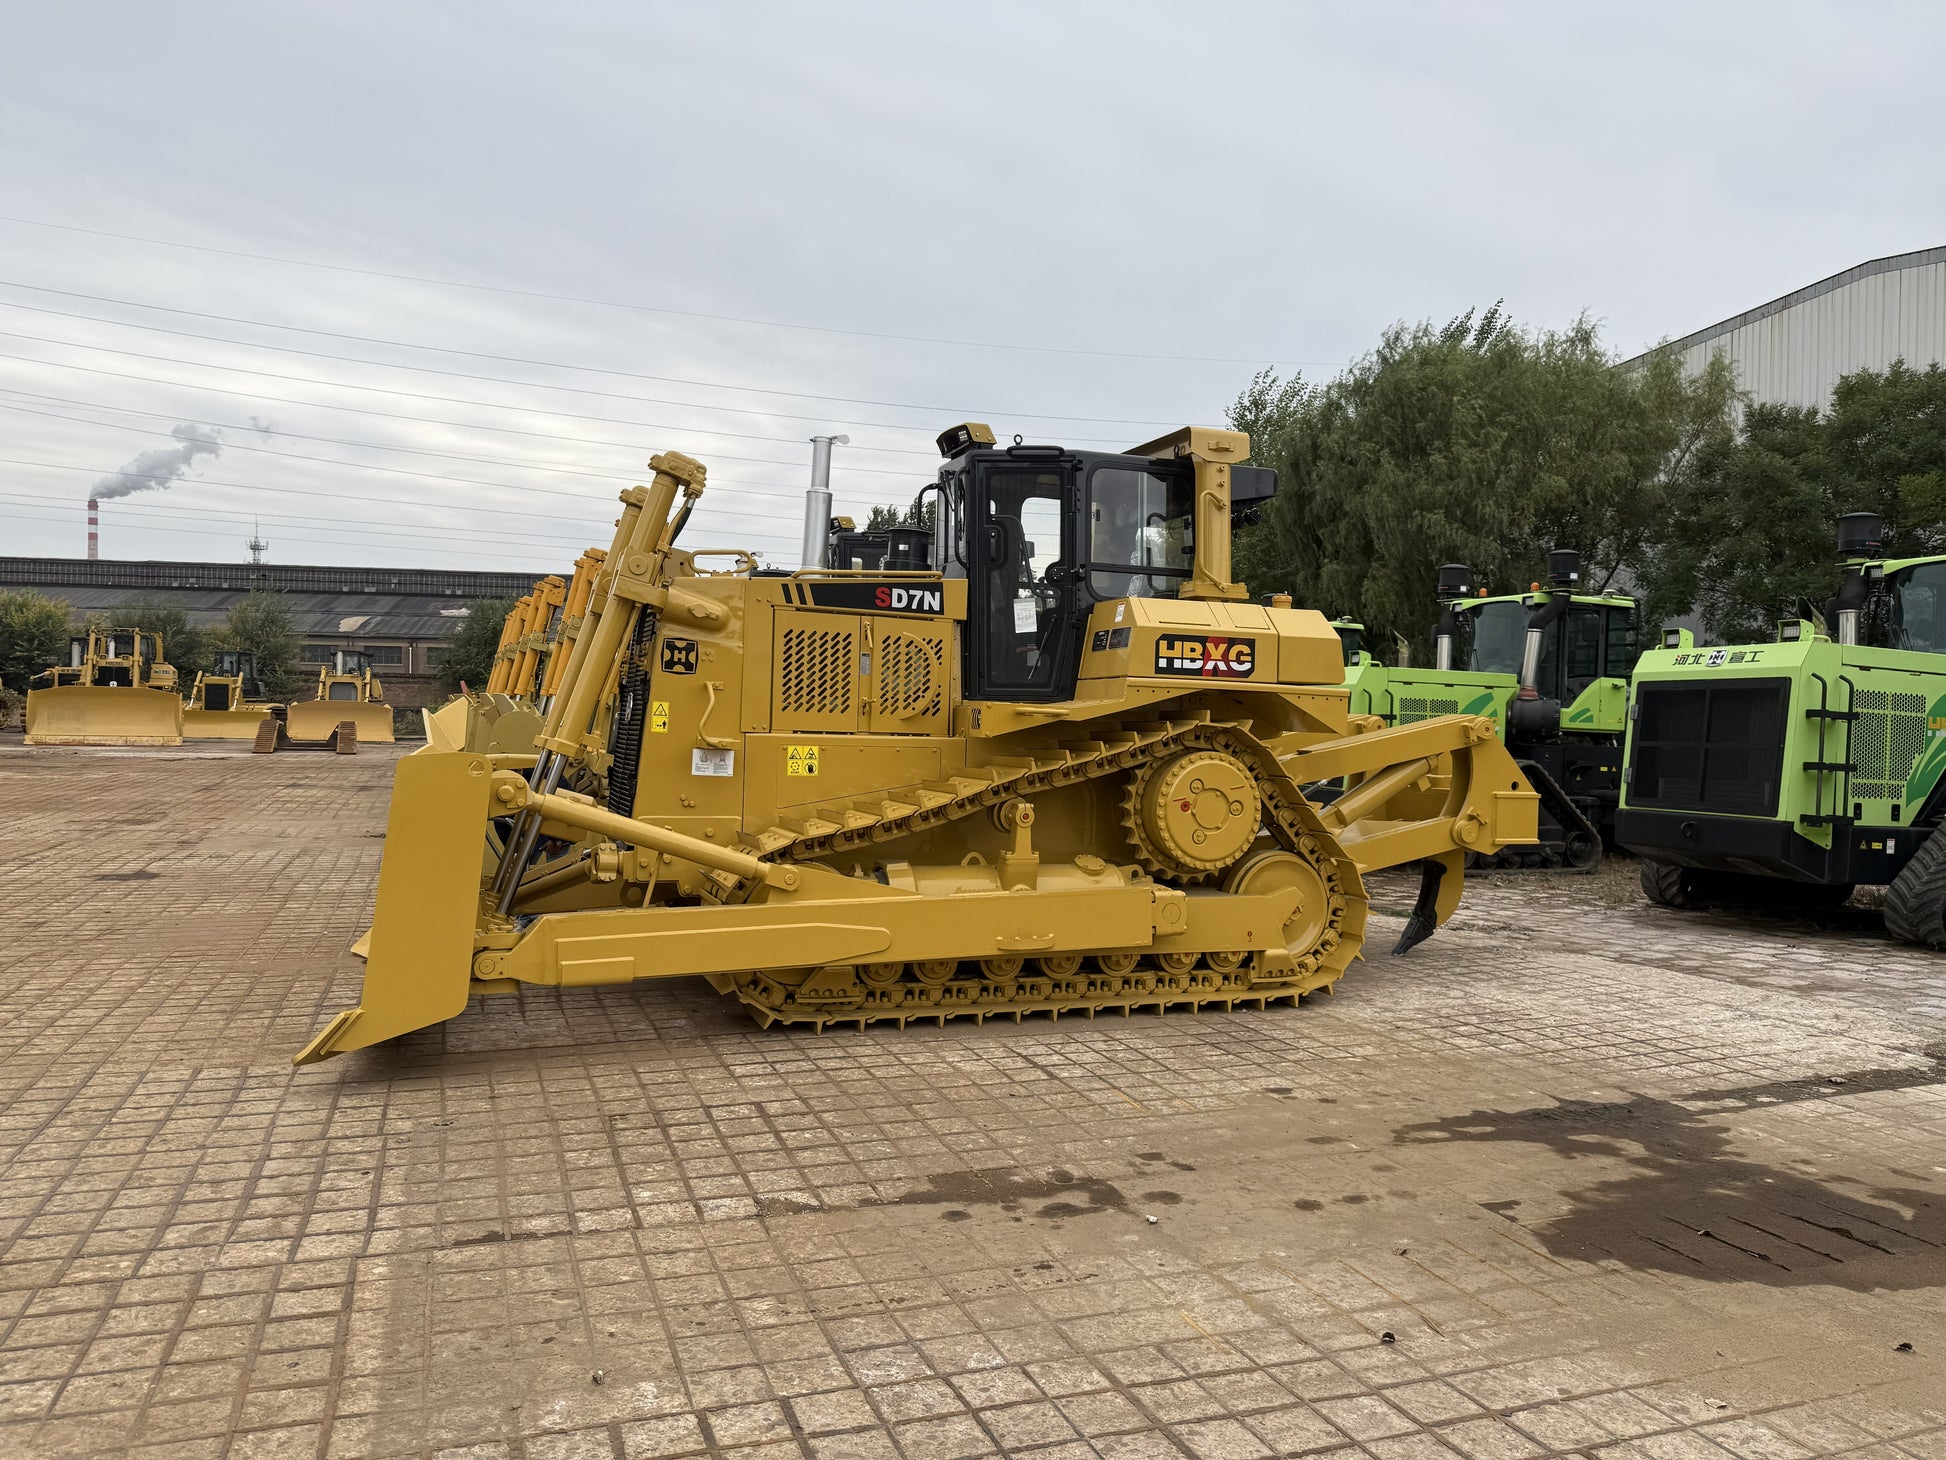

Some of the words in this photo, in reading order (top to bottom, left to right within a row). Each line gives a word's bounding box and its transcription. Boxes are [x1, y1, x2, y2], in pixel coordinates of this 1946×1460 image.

[875, 587, 941, 611] SD7N
[1158, 640, 1252, 671] HBXG
[1672, 653, 1706, 665] 河北
